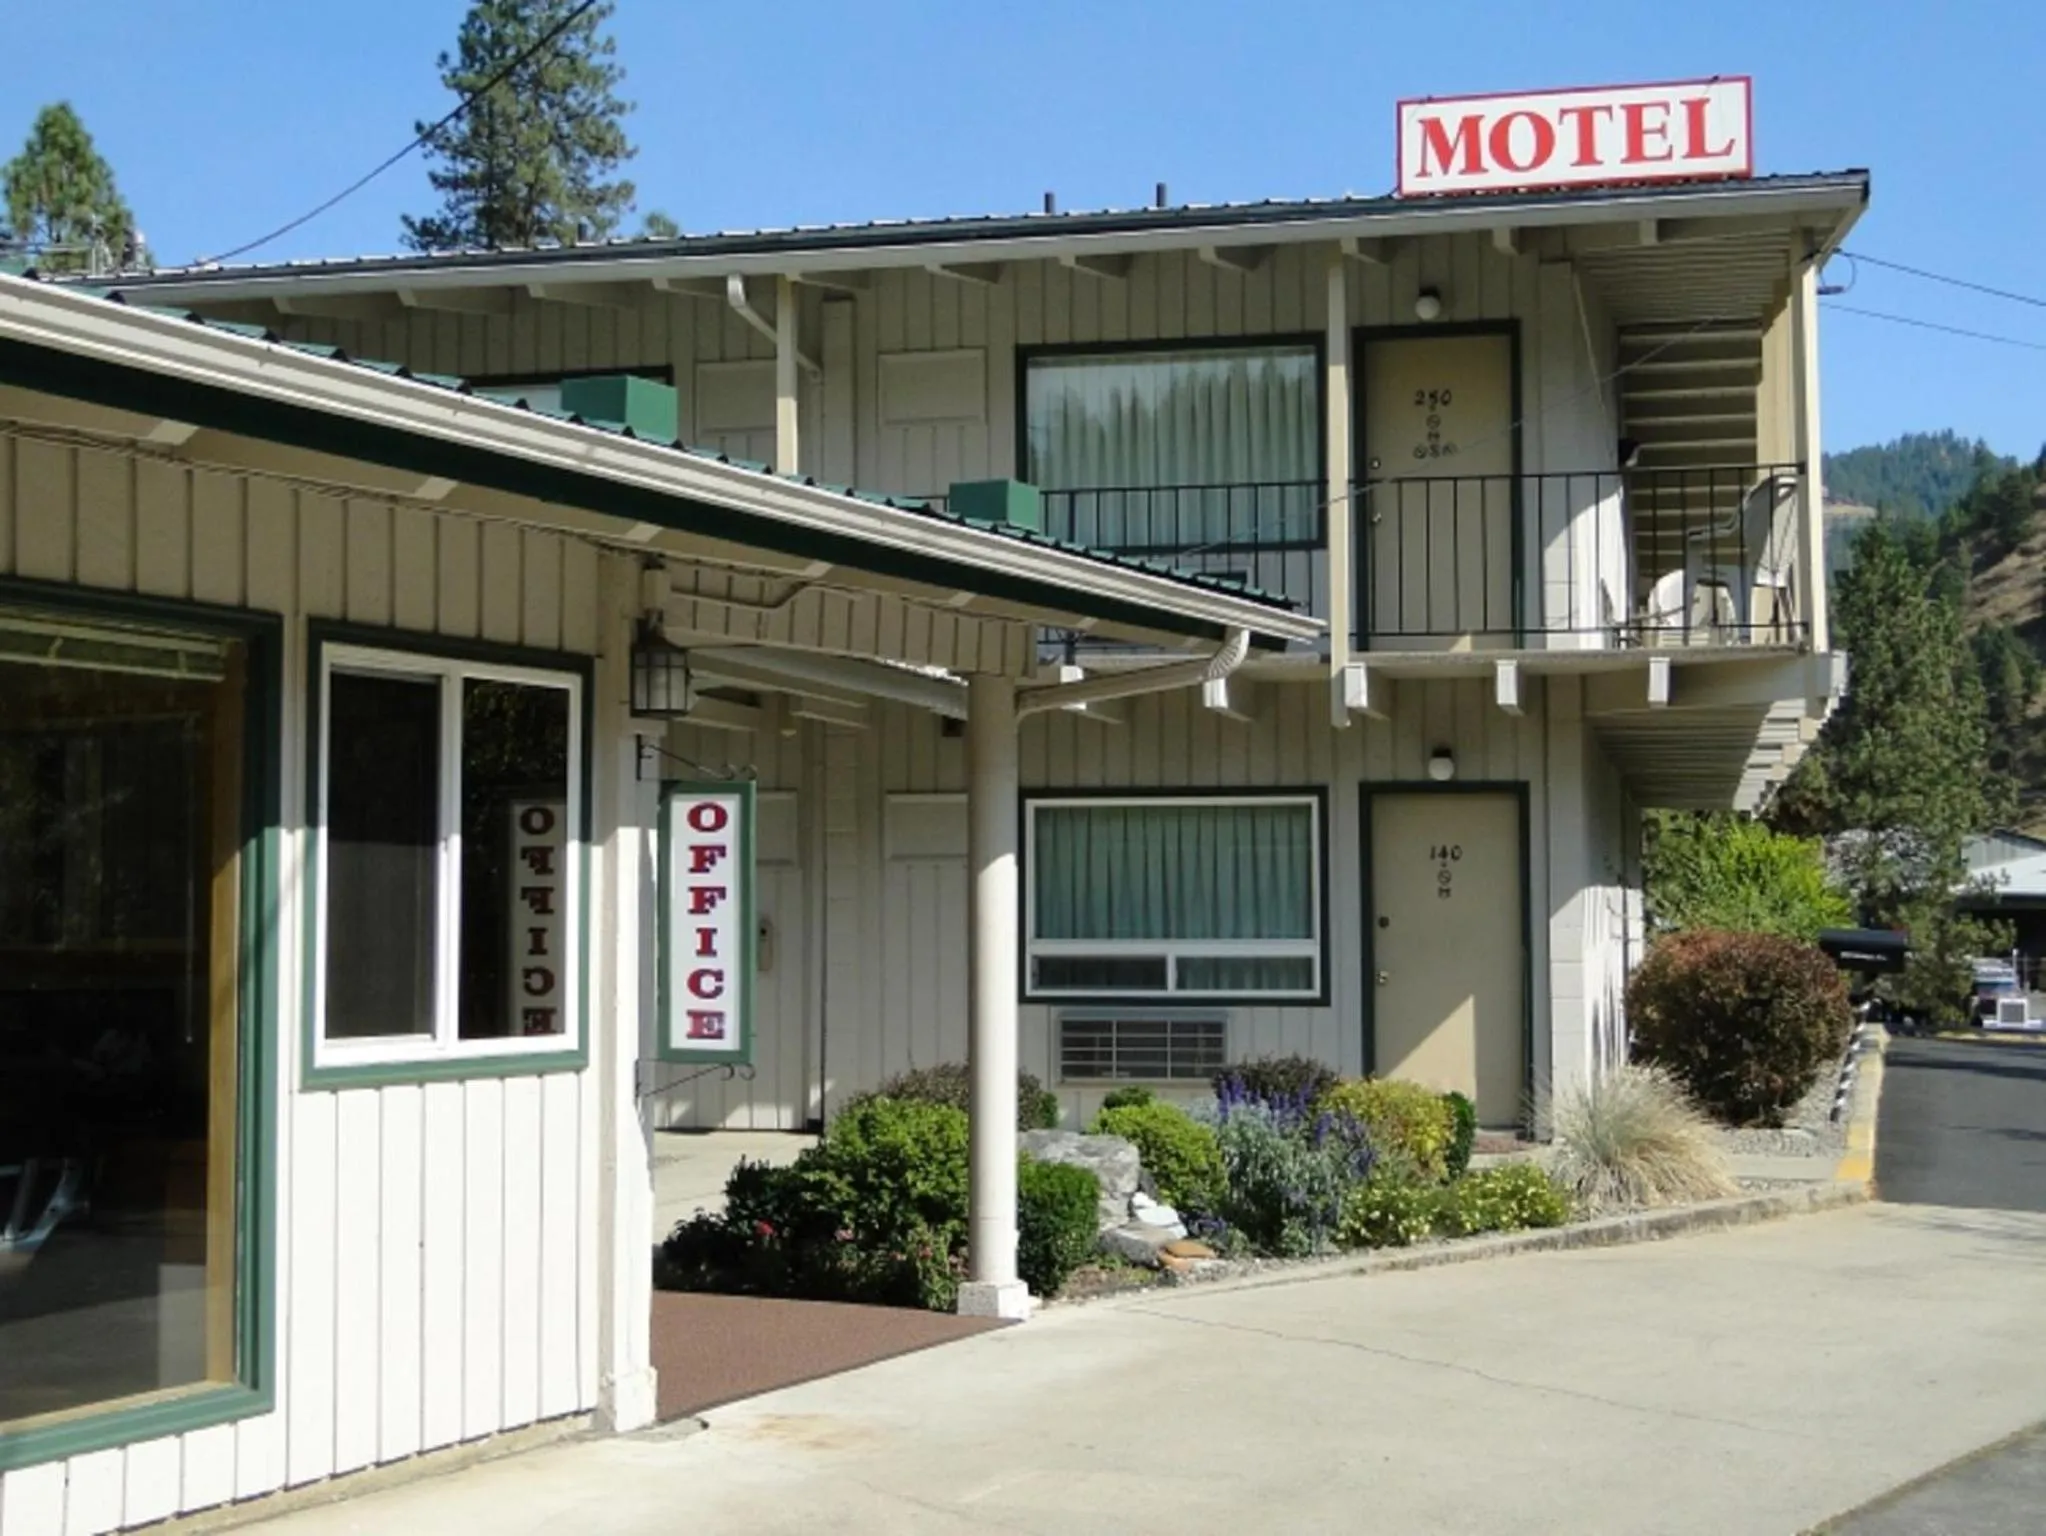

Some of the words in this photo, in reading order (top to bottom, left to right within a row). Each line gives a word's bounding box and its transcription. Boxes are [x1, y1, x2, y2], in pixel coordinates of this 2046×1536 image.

[1415, 98, 1735, 178] MOTEL
[1430, 845, 1462, 861] 140
[687, 802, 728, 1040] OFFICE
